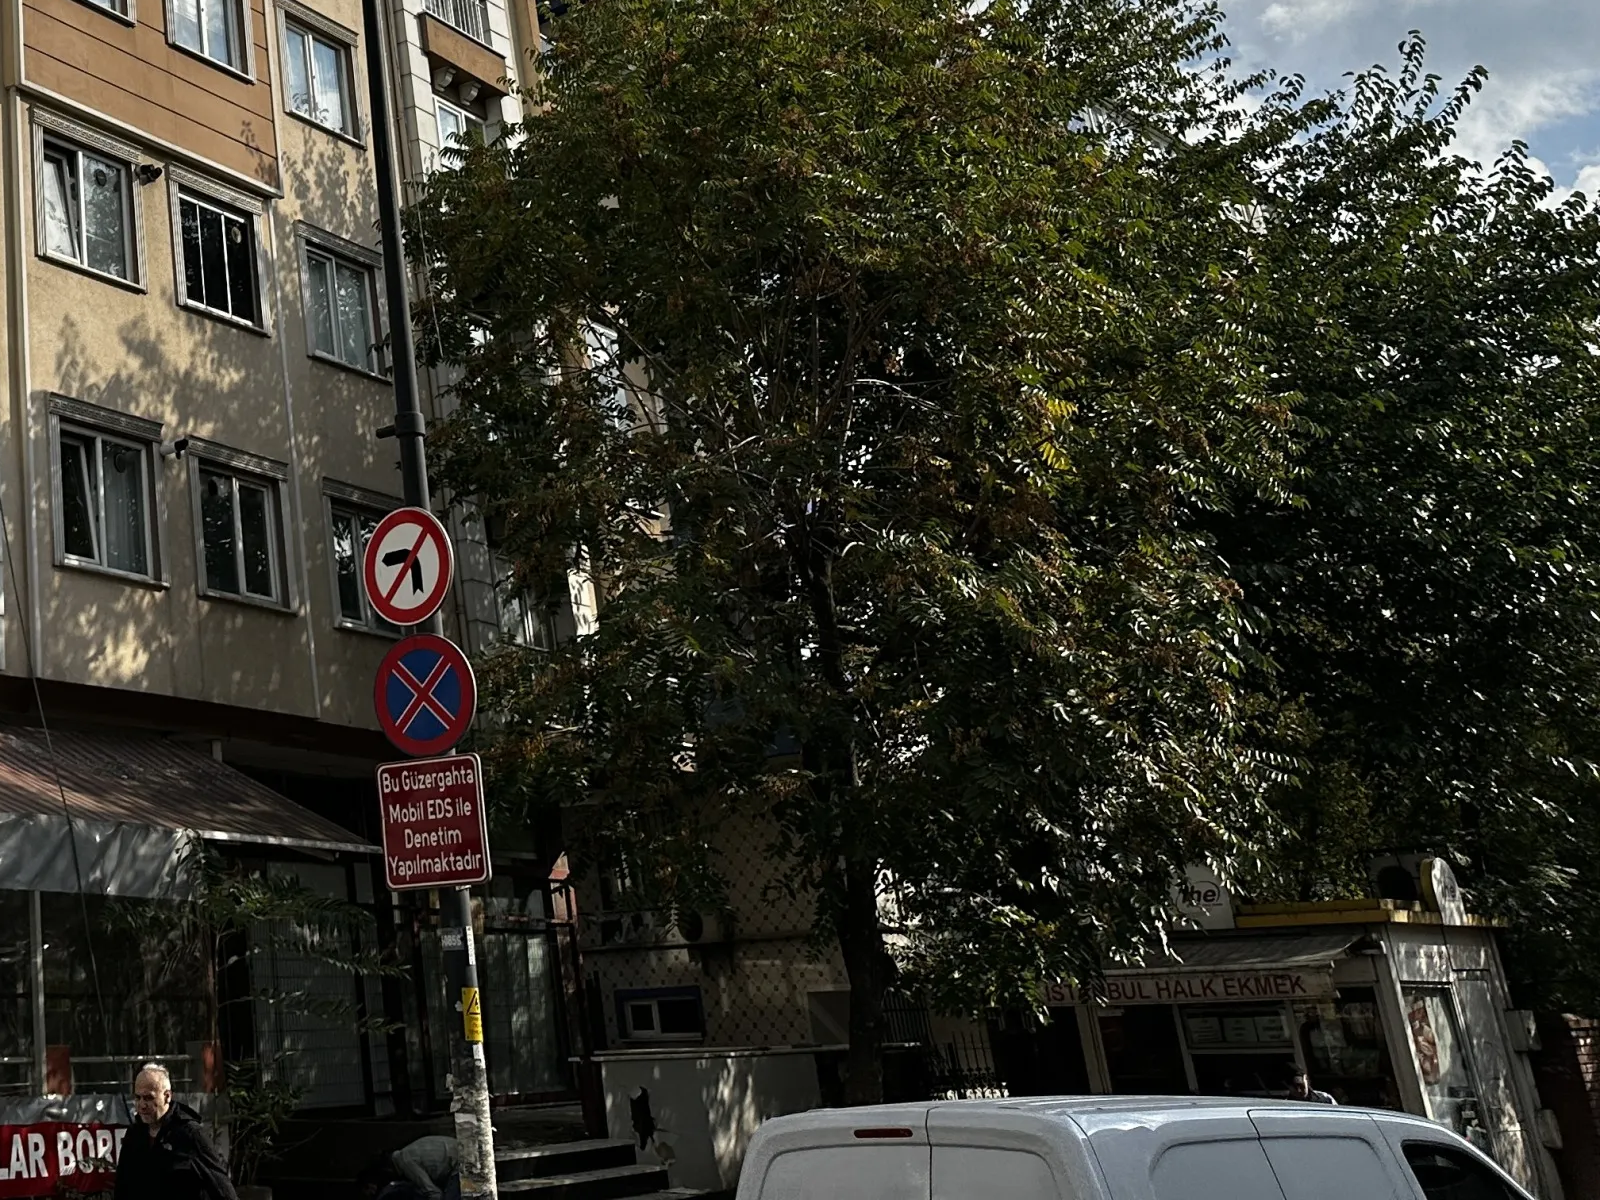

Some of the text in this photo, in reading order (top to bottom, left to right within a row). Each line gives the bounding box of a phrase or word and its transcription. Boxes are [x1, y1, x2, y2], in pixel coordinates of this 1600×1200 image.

[382, 765, 474, 793] Bu Güzergahta
[389, 798, 472, 824] Mobil EDS ile
[404, 826, 462, 849] Denetim
[389, 849, 482, 881] Yapılmaktadır
[1155, 978, 1217, 999] HALK
[1222, 975, 1306, 996] EKMEK
